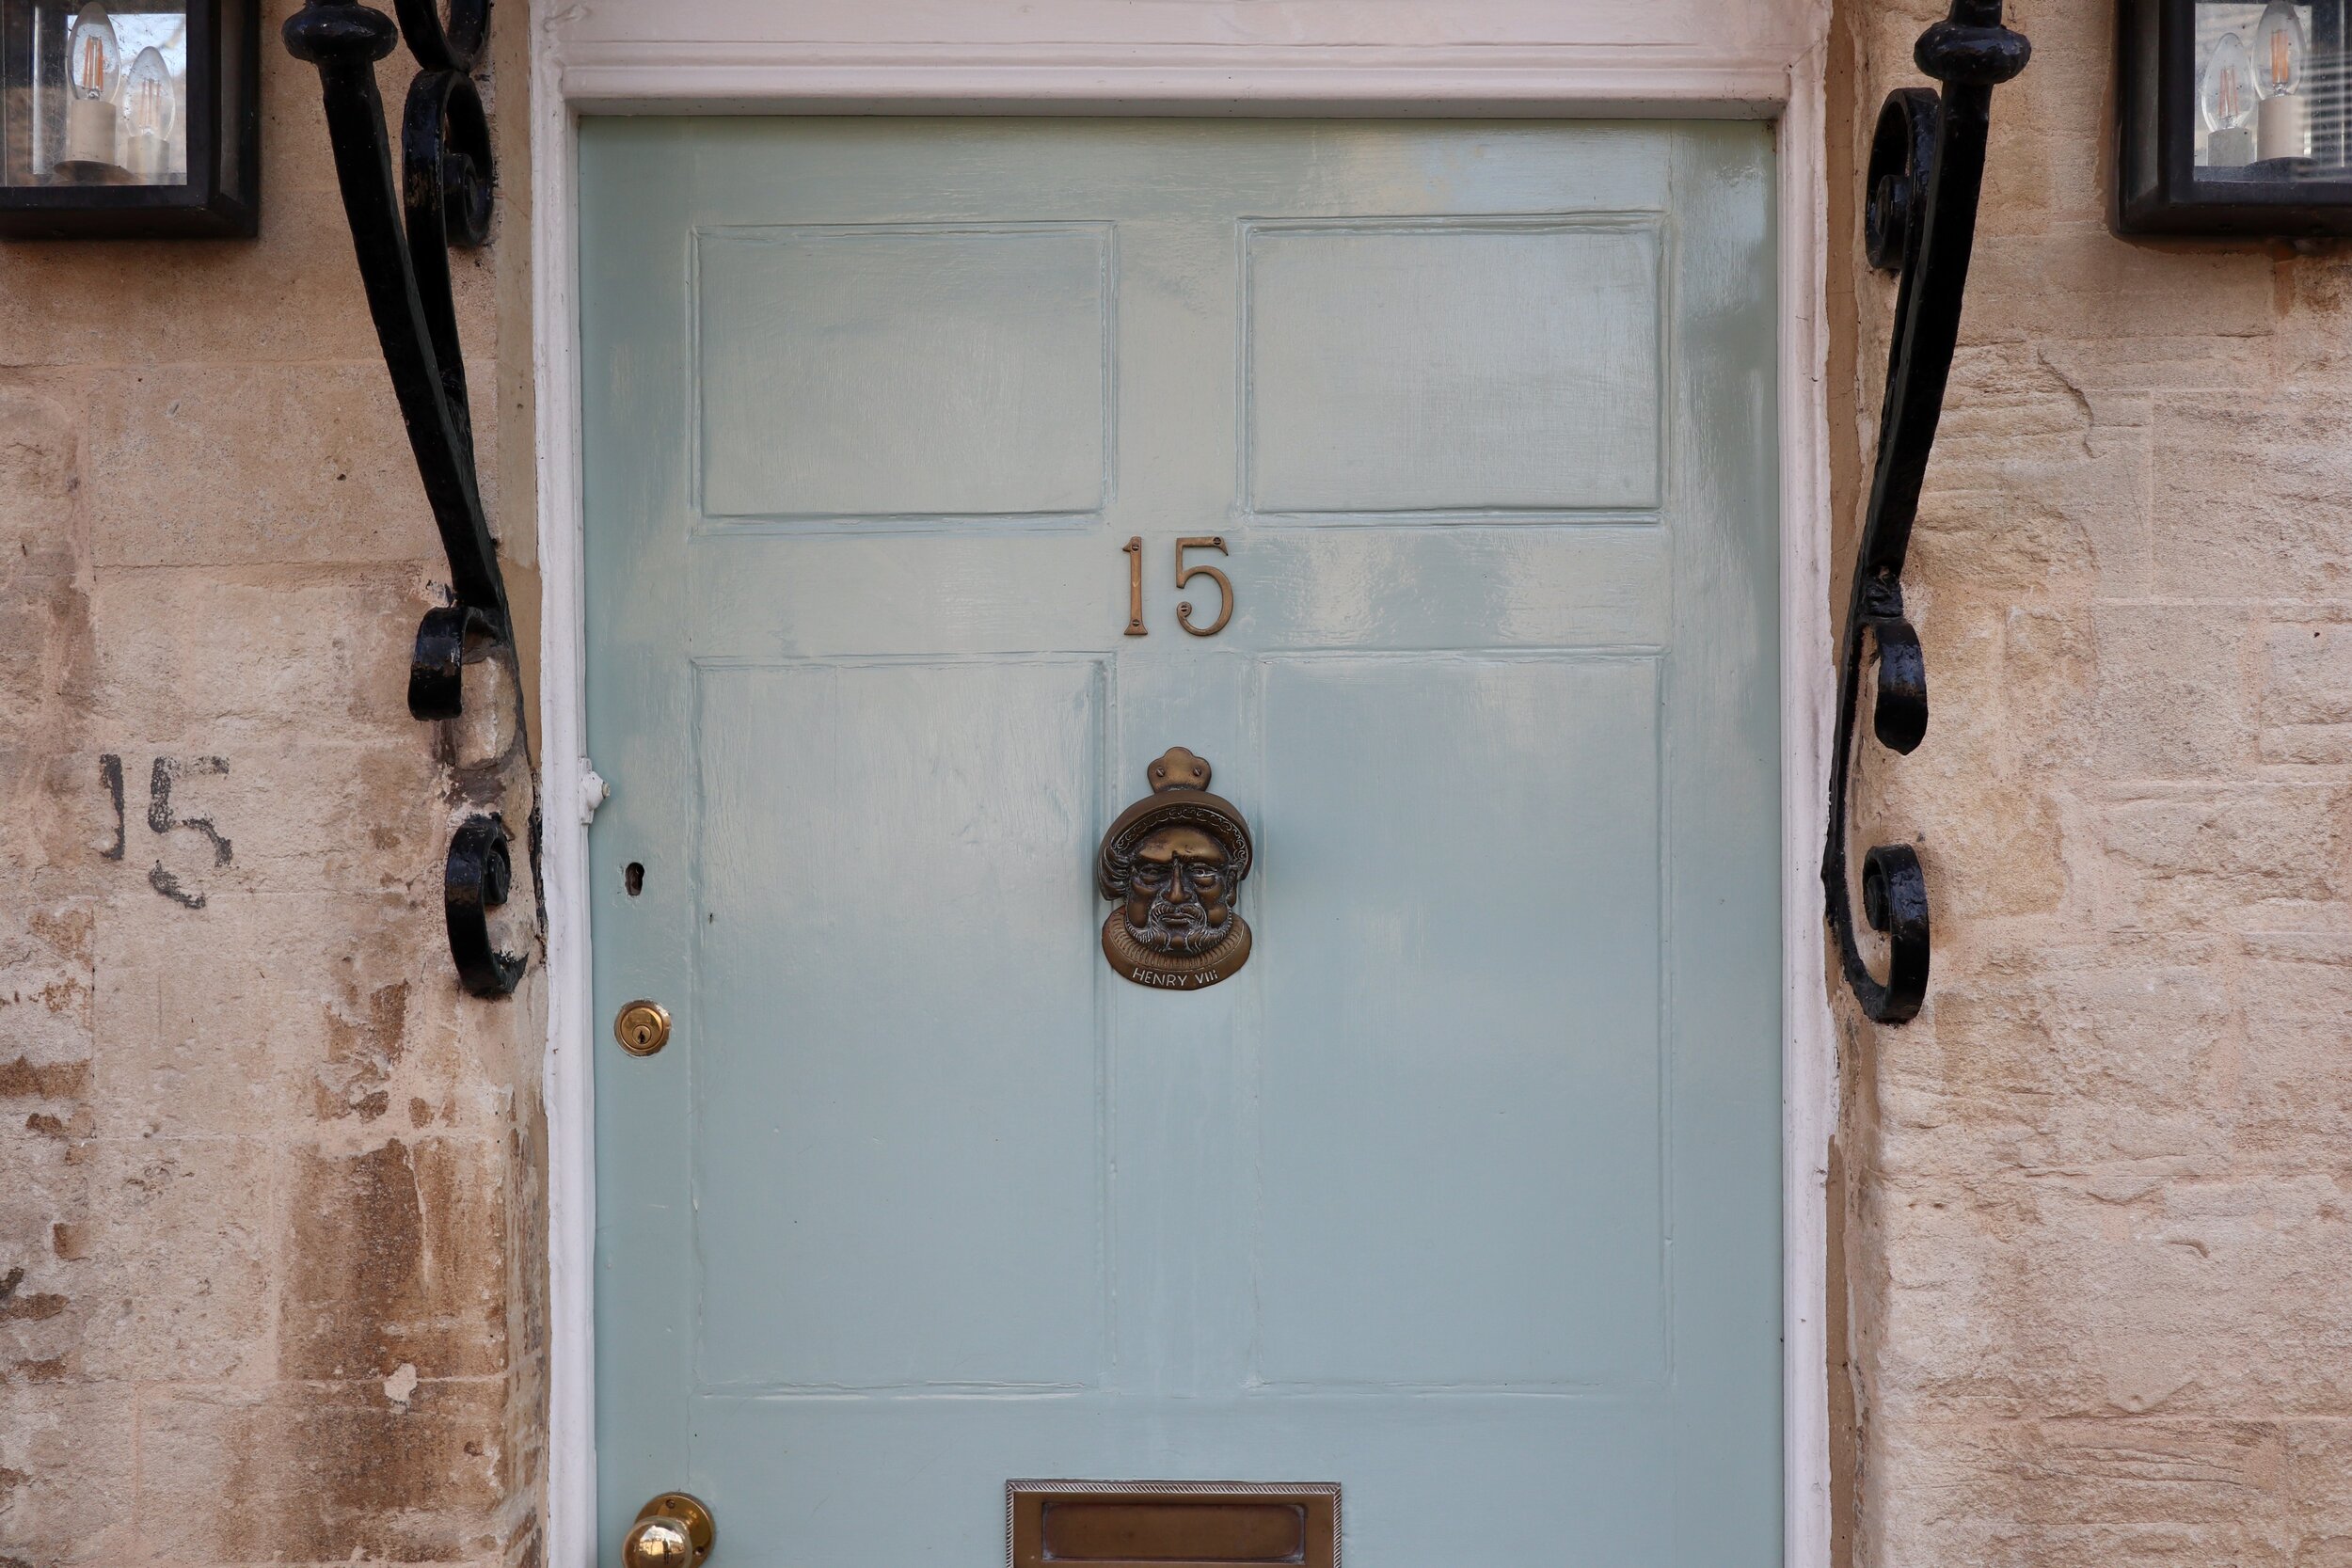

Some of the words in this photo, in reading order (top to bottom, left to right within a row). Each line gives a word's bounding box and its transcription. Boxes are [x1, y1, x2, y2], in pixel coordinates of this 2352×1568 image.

[1122, 536, 1233, 637] 15
[99, 753, 232, 910] 15
[1132, 967, 1188, 987] HENRY
